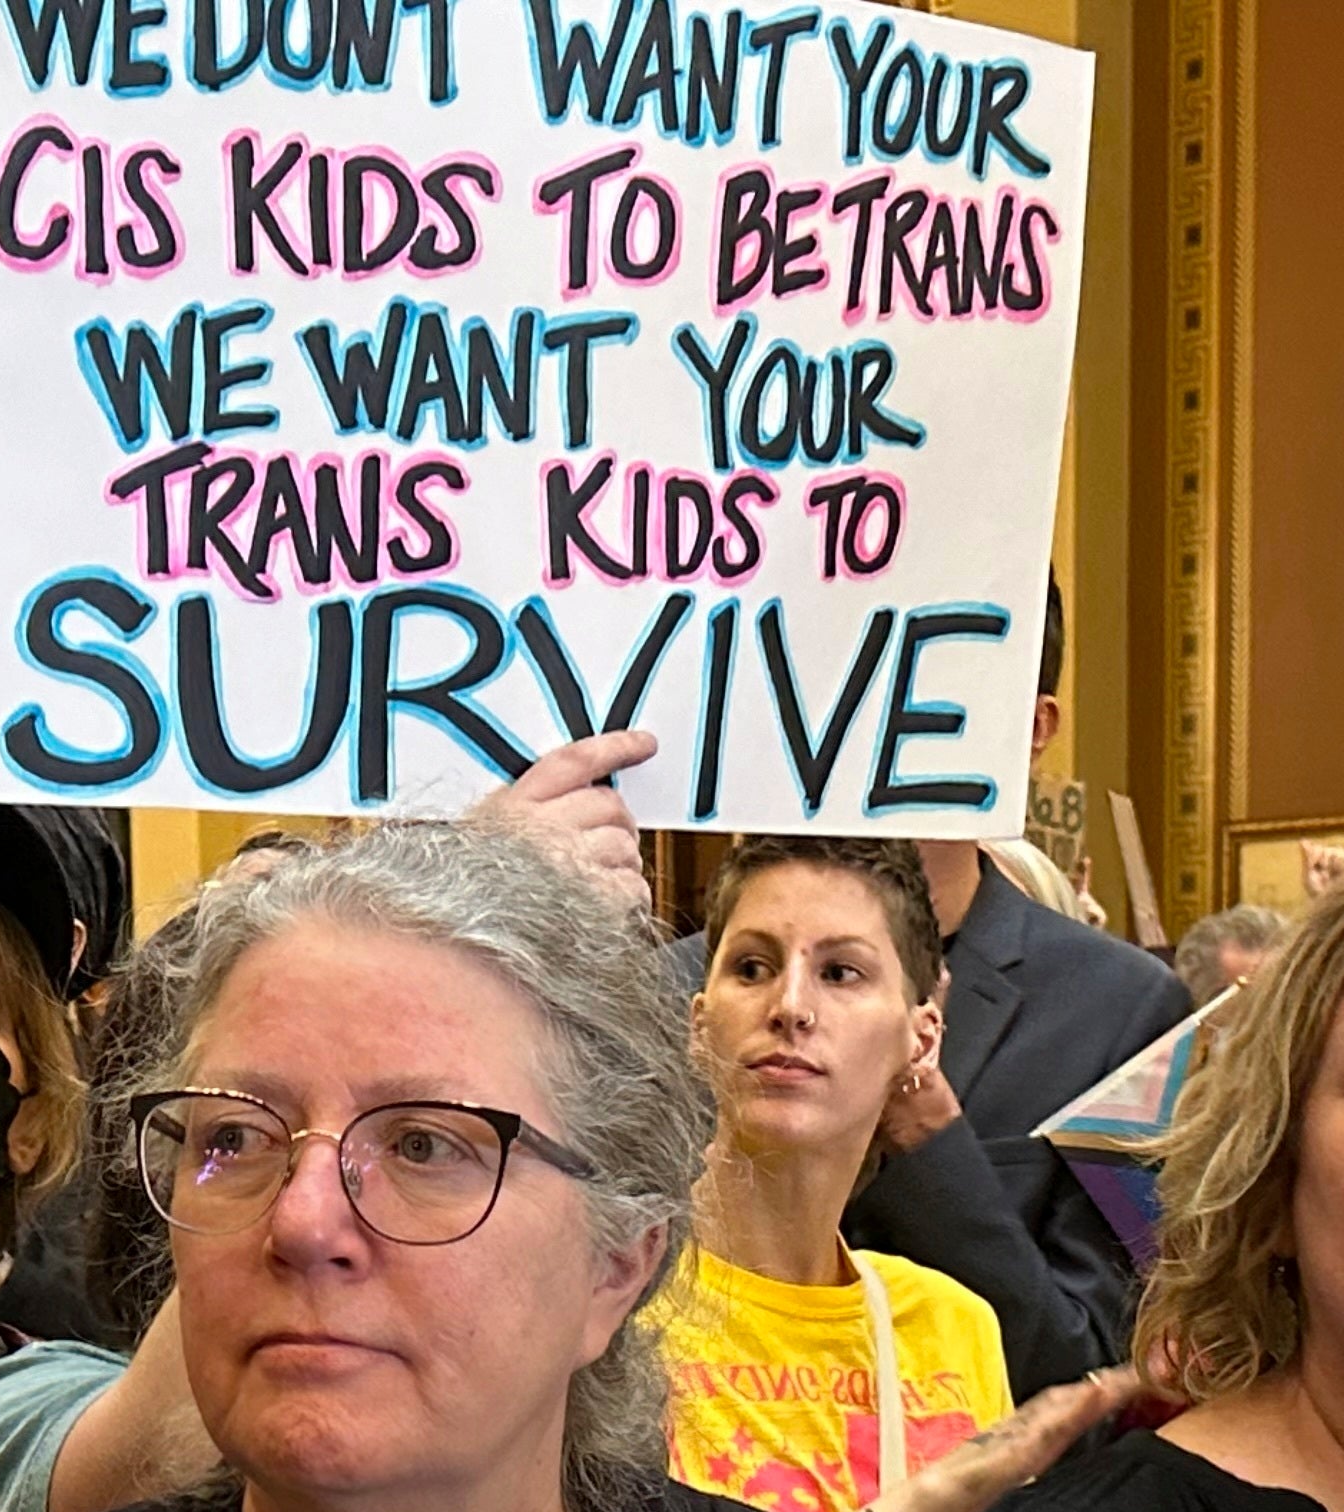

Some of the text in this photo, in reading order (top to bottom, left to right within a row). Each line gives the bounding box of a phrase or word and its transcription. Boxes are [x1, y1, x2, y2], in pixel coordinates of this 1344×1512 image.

[6, 0, 171, 96] WE
[528, 0, 821, 148] WANT
[831, 19, 1051, 178] YOUR
[223, 128, 502, 280] KIDS
[534, 144, 679, 297] TO
[715, 163, 826, 310] BE
[828, 171, 1058, 324] TRANS
[78, 299, 926, 470] WE WANT YOUR
[106, 443, 903, 601] TRANS KIDS TO
[1, 568, 1008, 822] SURVIVE
